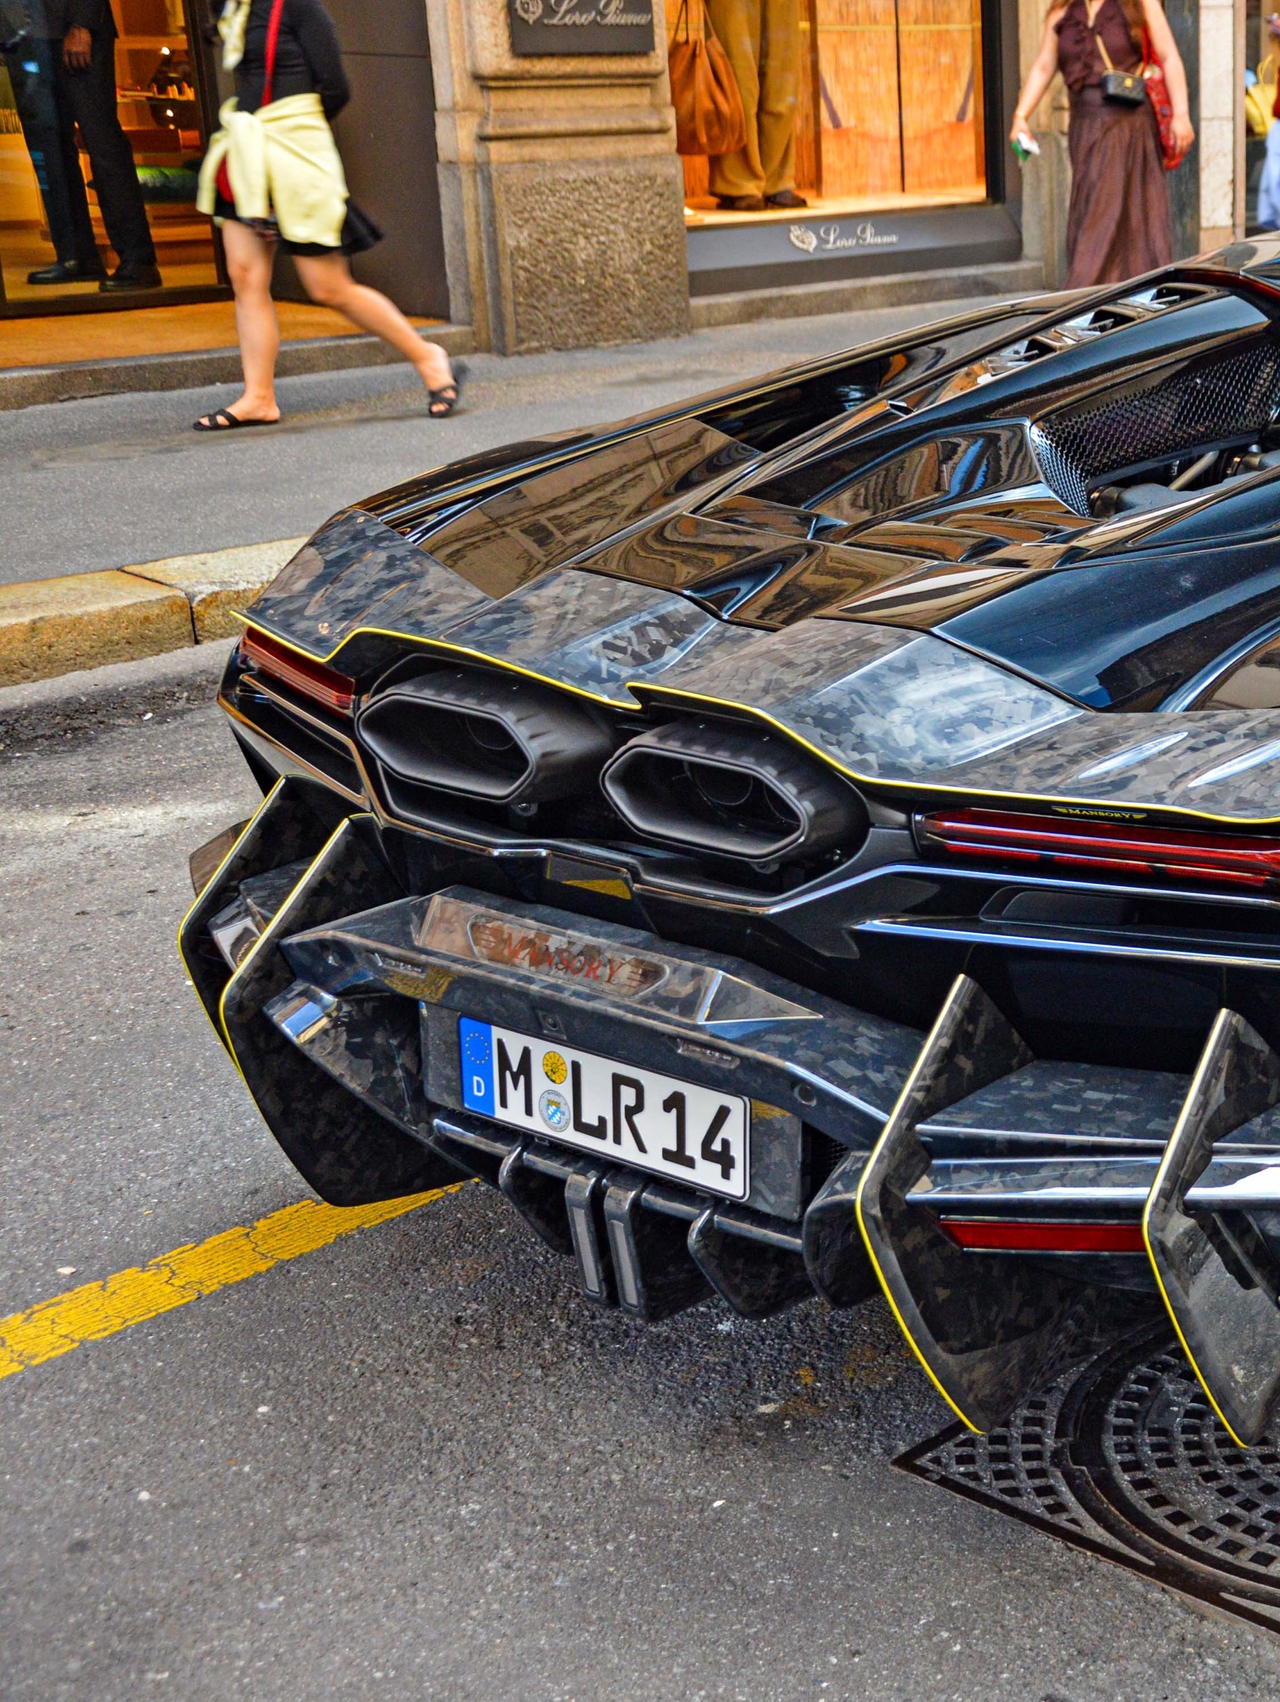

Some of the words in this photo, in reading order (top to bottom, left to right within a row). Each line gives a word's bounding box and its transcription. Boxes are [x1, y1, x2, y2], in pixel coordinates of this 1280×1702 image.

[544, 0, 596, 25] Loro
[597, 0, 652, 25] Piana
[820, 224, 857, 251] Loro
[857, 221, 899, 246] Piana
[1068, 808, 1131, 819] MANSORY
[504, 931, 627, 984] MANSORY
[472, 1075, 485, 1097] D
